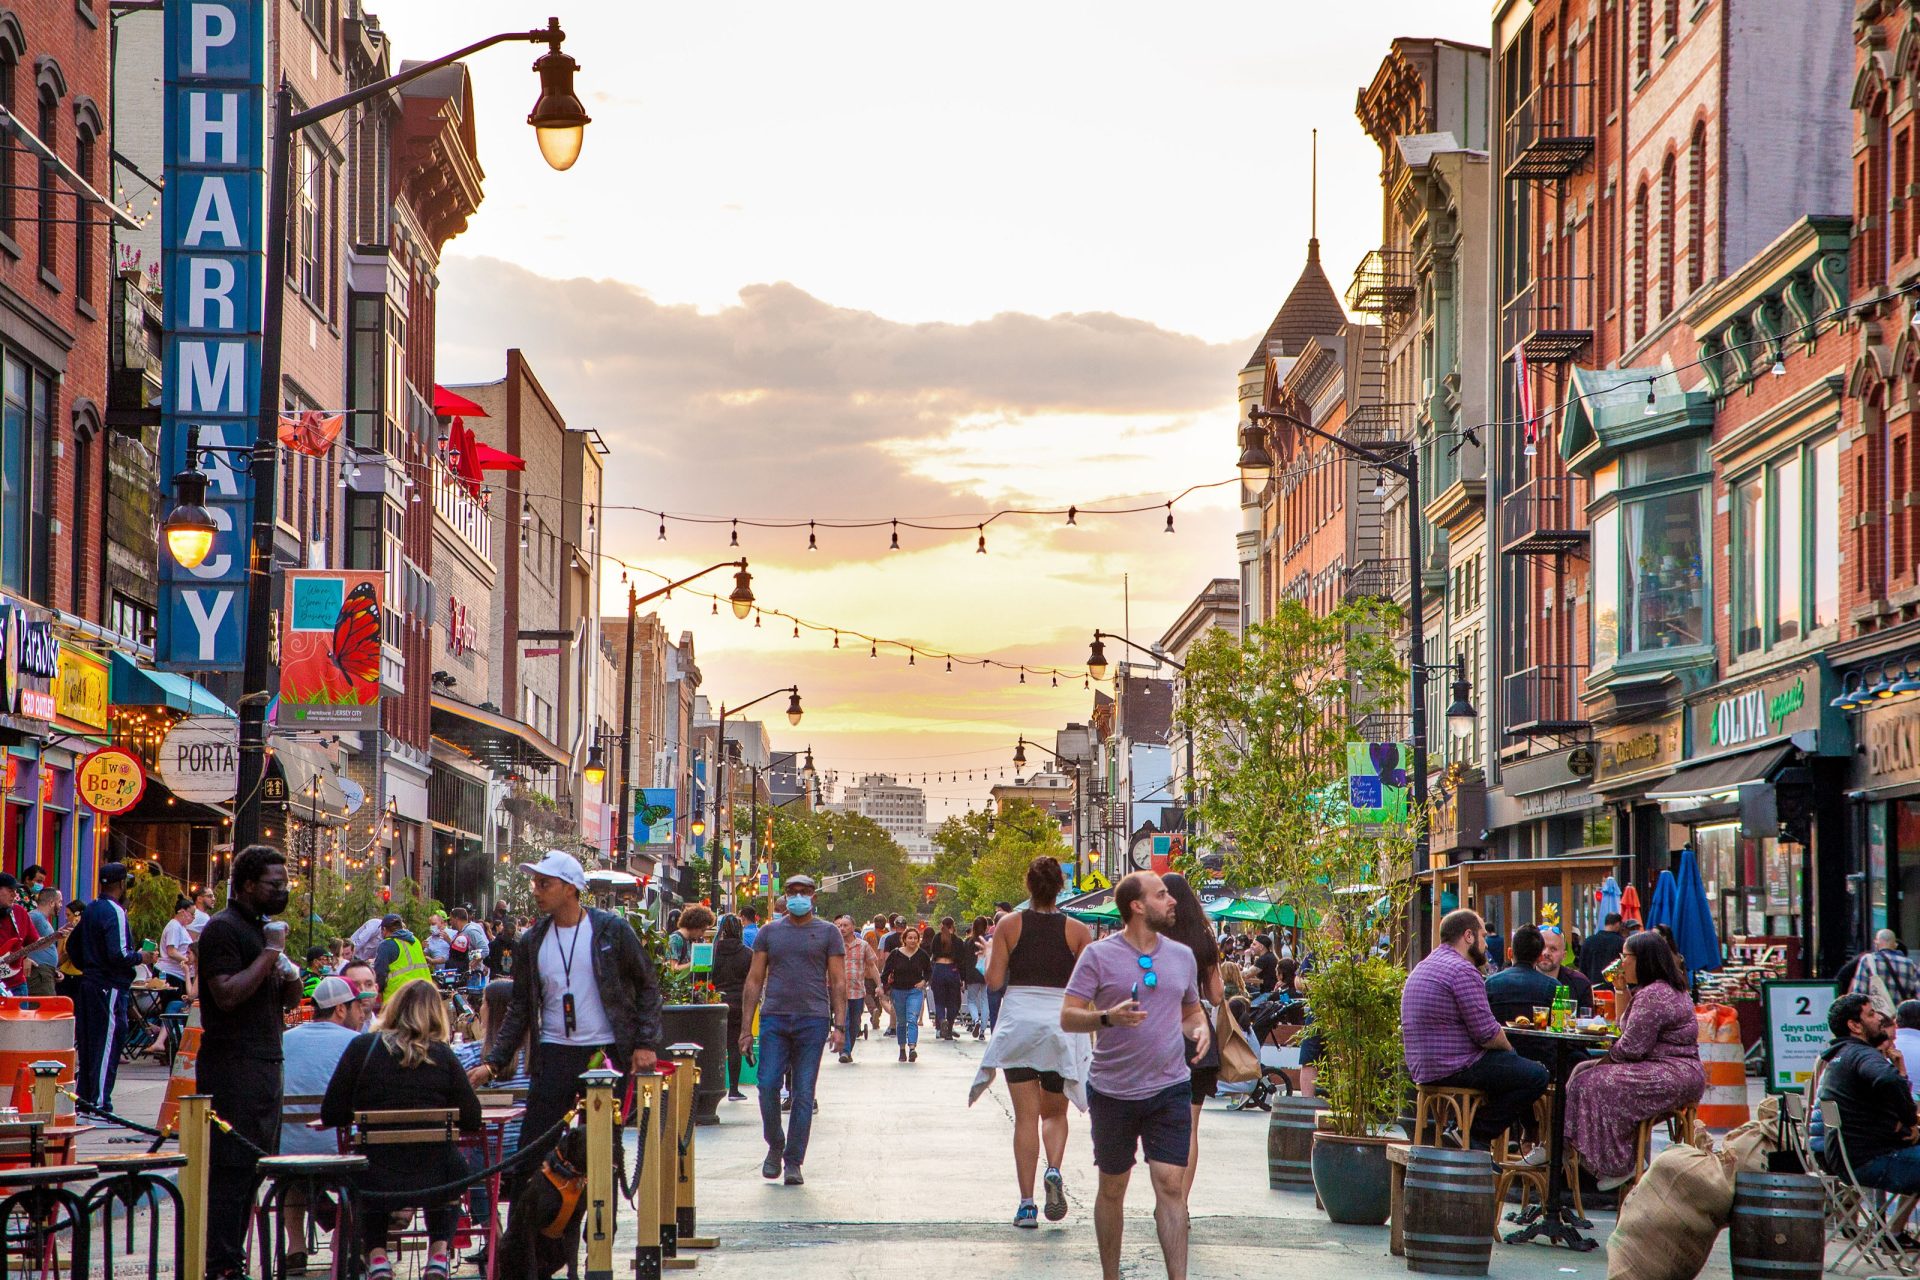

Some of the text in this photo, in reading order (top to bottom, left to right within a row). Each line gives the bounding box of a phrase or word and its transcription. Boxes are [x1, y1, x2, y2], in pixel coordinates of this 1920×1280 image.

[35, 695, 54, 719] OUTLET
[1718, 689, 1768, 747] OLIVA
[177, 744, 235, 772] PORTA
[1796, 997, 1812, 1015] 2
[1780, 1022, 1829, 1033] days until
[1784, 1033, 1826, 1043] Tax Day.
